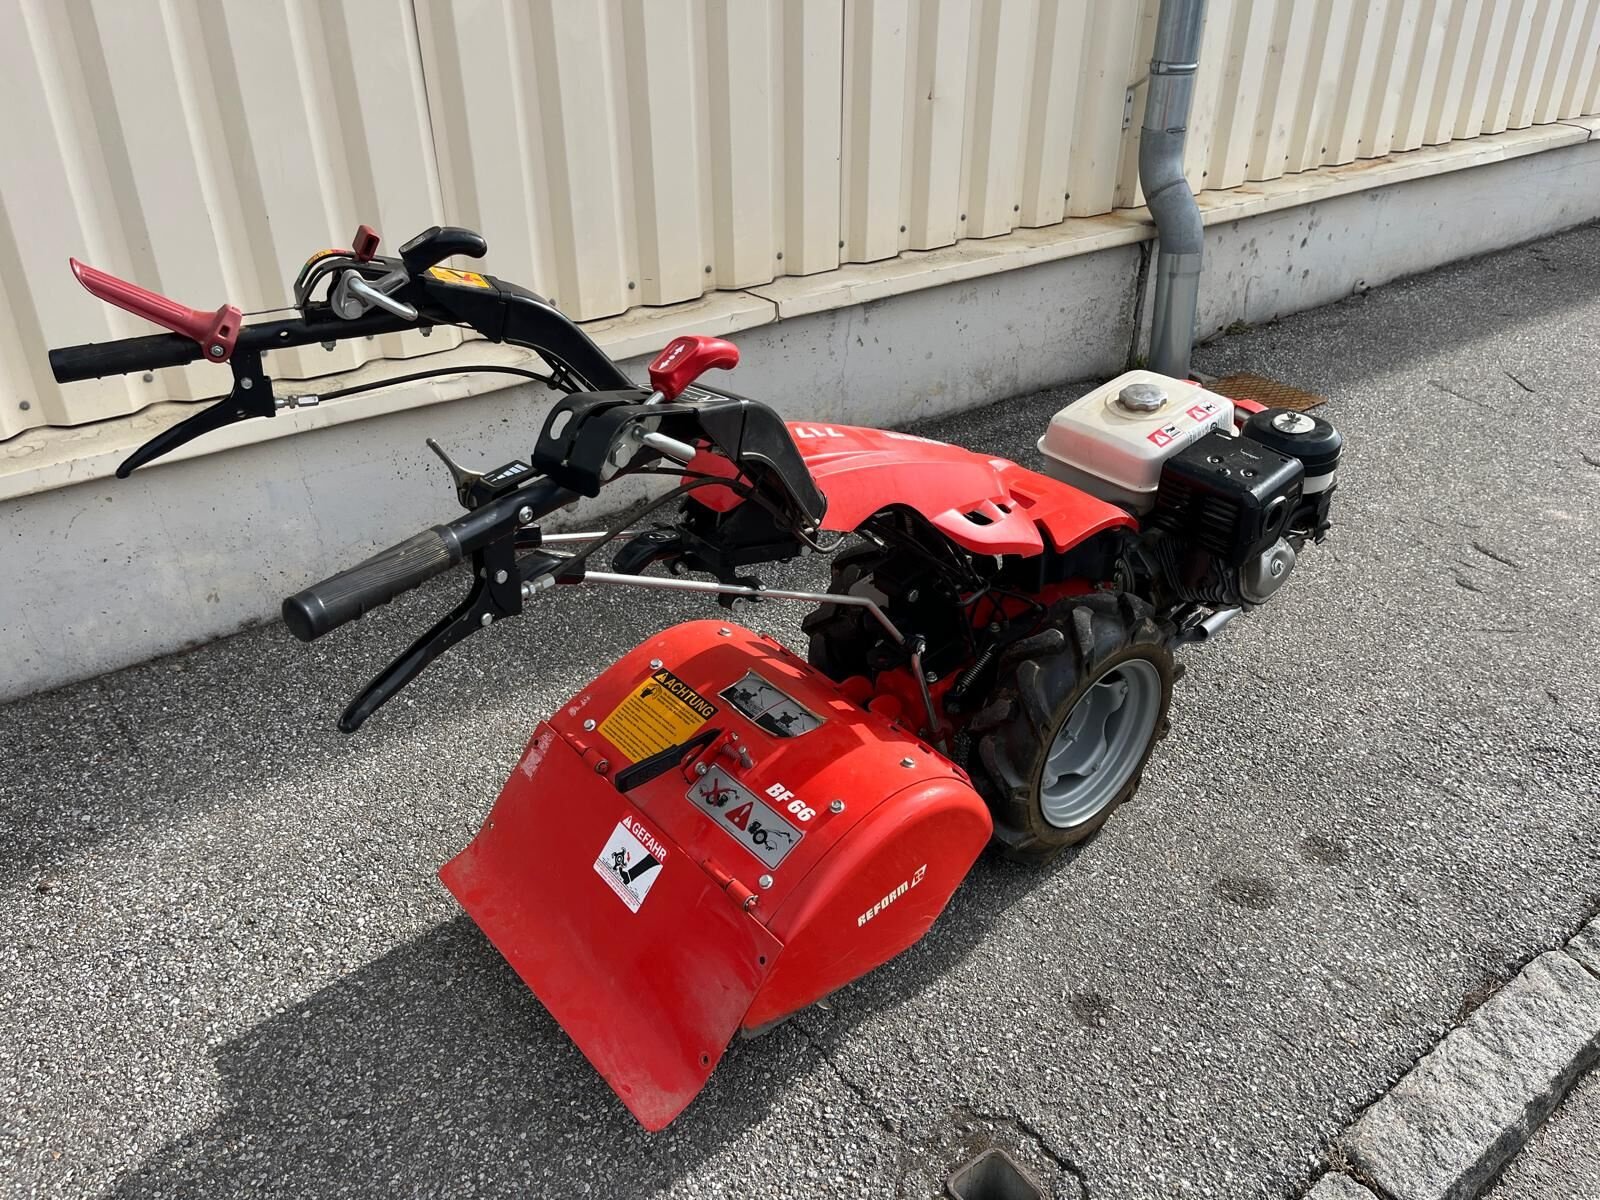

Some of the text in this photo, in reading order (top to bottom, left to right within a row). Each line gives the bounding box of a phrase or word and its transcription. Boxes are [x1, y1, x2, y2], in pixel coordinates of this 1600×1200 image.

[664, 678, 715, 717] ACHTUNG
[765, 782, 817, 821] BF 66
[632, 822, 667, 862] GEFAHR
[857, 880, 909, 927] REFORM
